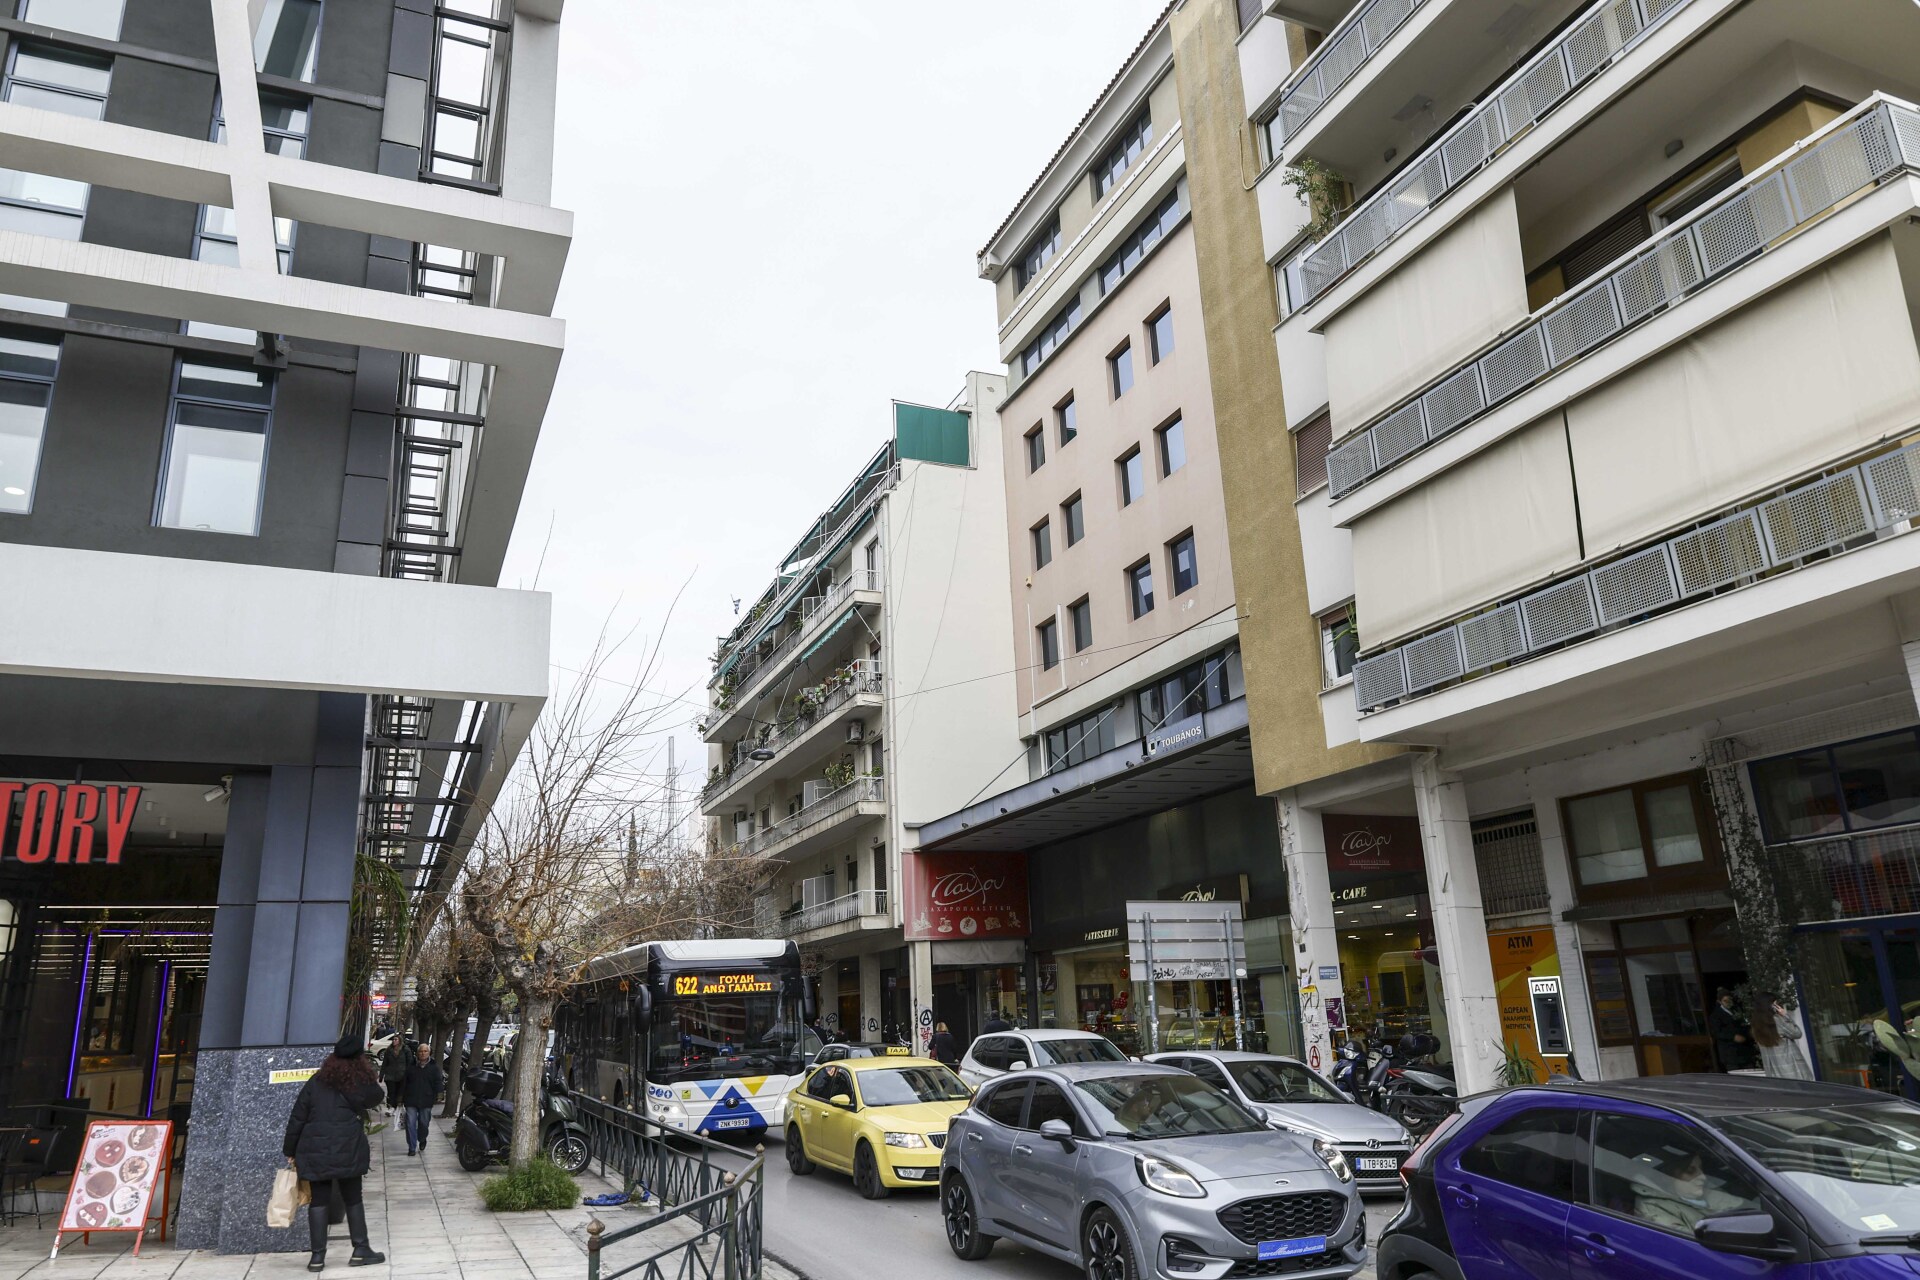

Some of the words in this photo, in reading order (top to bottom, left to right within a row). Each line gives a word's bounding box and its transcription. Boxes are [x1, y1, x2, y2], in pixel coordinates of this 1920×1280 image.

[0, 781, 142, 864] TORY
[1342, 886, 1367, 900] CAFE
[1084, 928, 1120, 942] PATISSERIE
[1507, 936, 1533, 949] ATM
[675, 976, 698, 995] 622
[719, 974, 755, 985] ΓΟΥΔΗ
[702, 984, 726, 994] ΑΝΩ
[728, 982, 772, 993] ΓΑΛΑΤΣΙ
[1534, 983, 1555, 993] ATM
[1503, 1006, 1529, 1014] ΔΩΡΕΑΝ
[275, 1070, 317, 1078] ΠΩΛΕΙΤΑ
